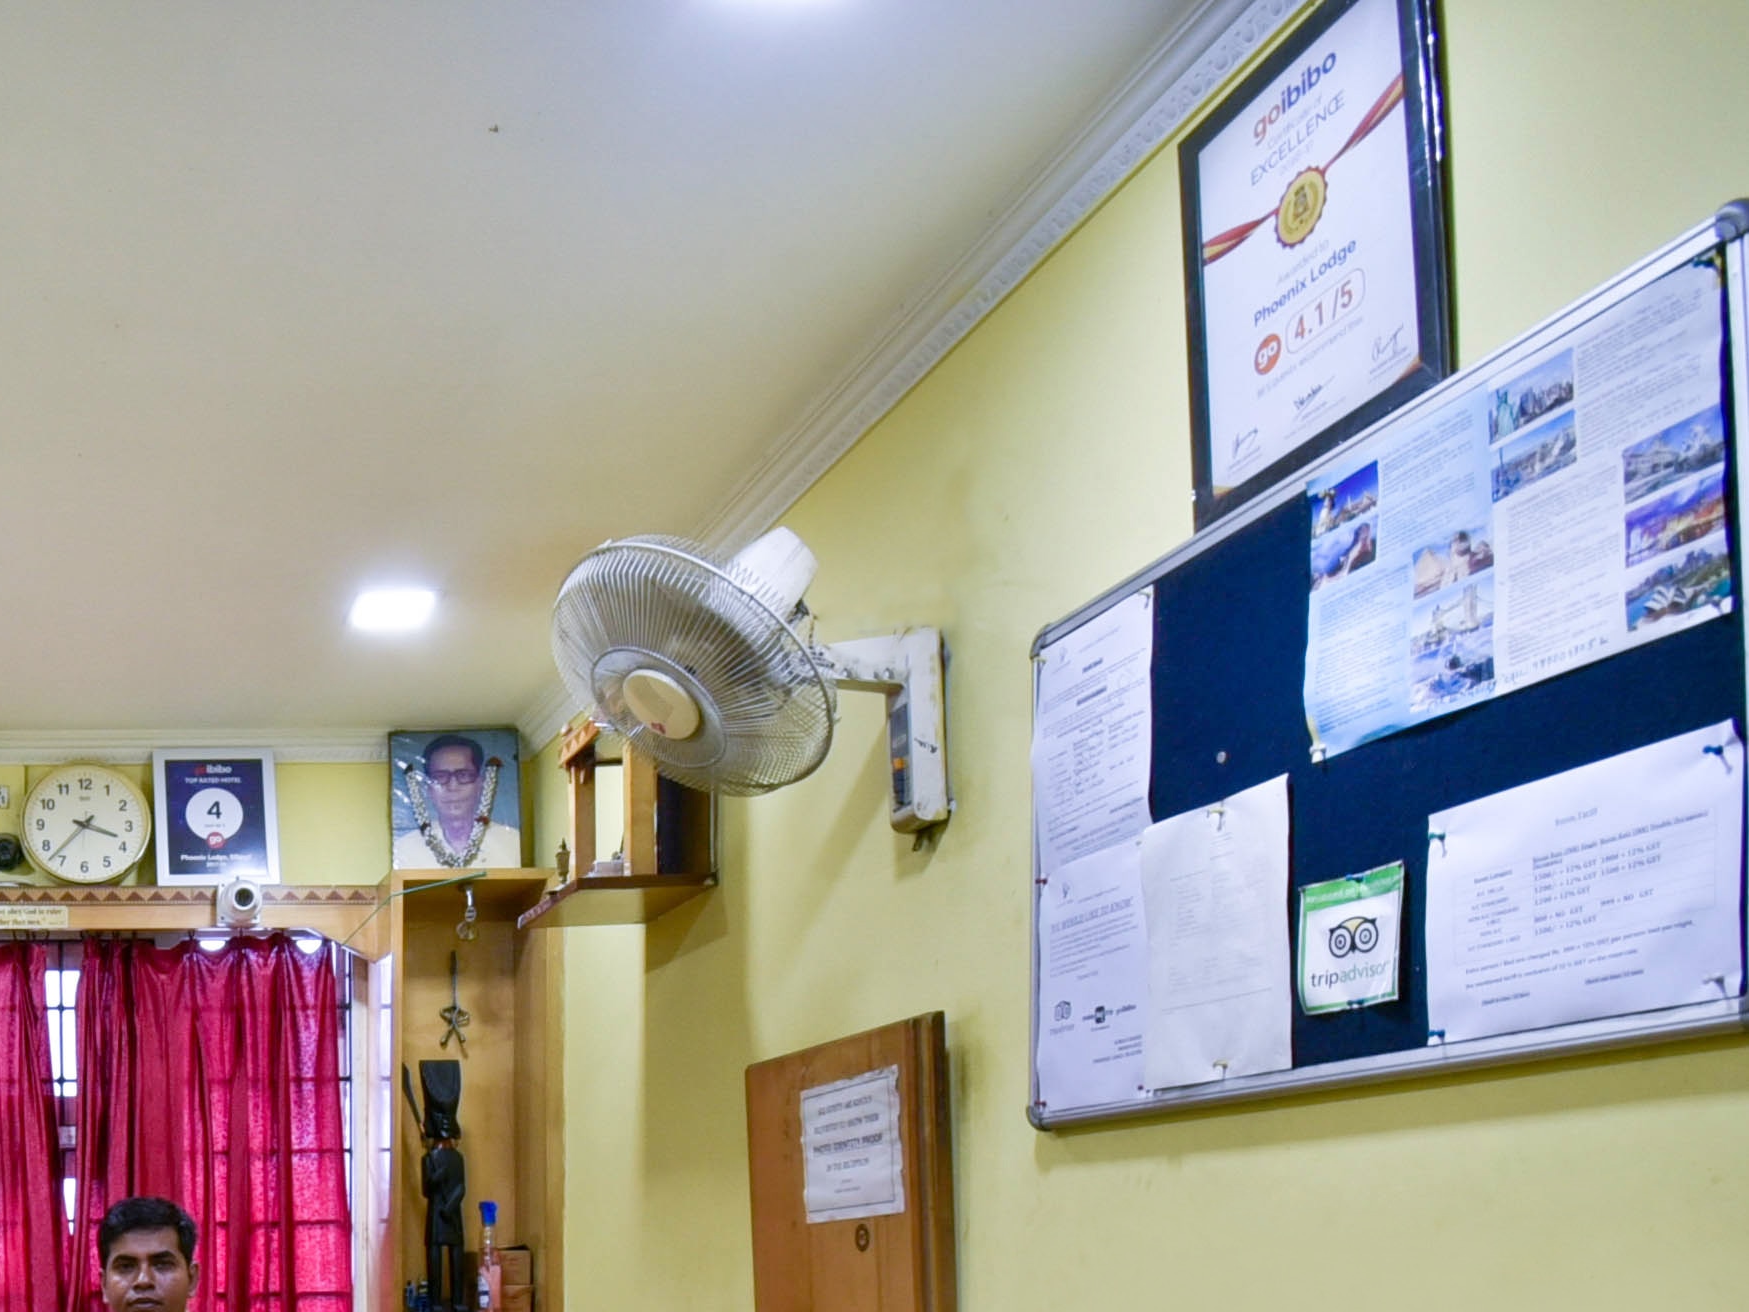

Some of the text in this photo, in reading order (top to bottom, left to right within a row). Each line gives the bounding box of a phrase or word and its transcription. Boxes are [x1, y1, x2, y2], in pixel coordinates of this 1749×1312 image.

[1253, 52, 1337, 147] goibibo
[1251, 88, 1346, 187] EXCELLENCE
[1253, 240, 1357, 328] Phoenix Lodge
[1257, 341, 1279, 371] go
[57, 783, 69, 795] 11
[77, 778, 92, 791] 12
[104, 784, 110, 796] 1
[40, 798, 55, 810] 10
[118, 799, 127, 812] 2
[206, 800, 223, 820] 4
[36, 818, 45, 831] 9
[124, 820, 133, 832] 3
[41, 839, 51, 852] 8
[118, 841, 127, 853] 4
[58, 855, 67, 867] 7
[80, 860, 89, 873] 6
[102, 856, 111, 868] 5
[1310, 960, 1389, 989] tripadvisor
